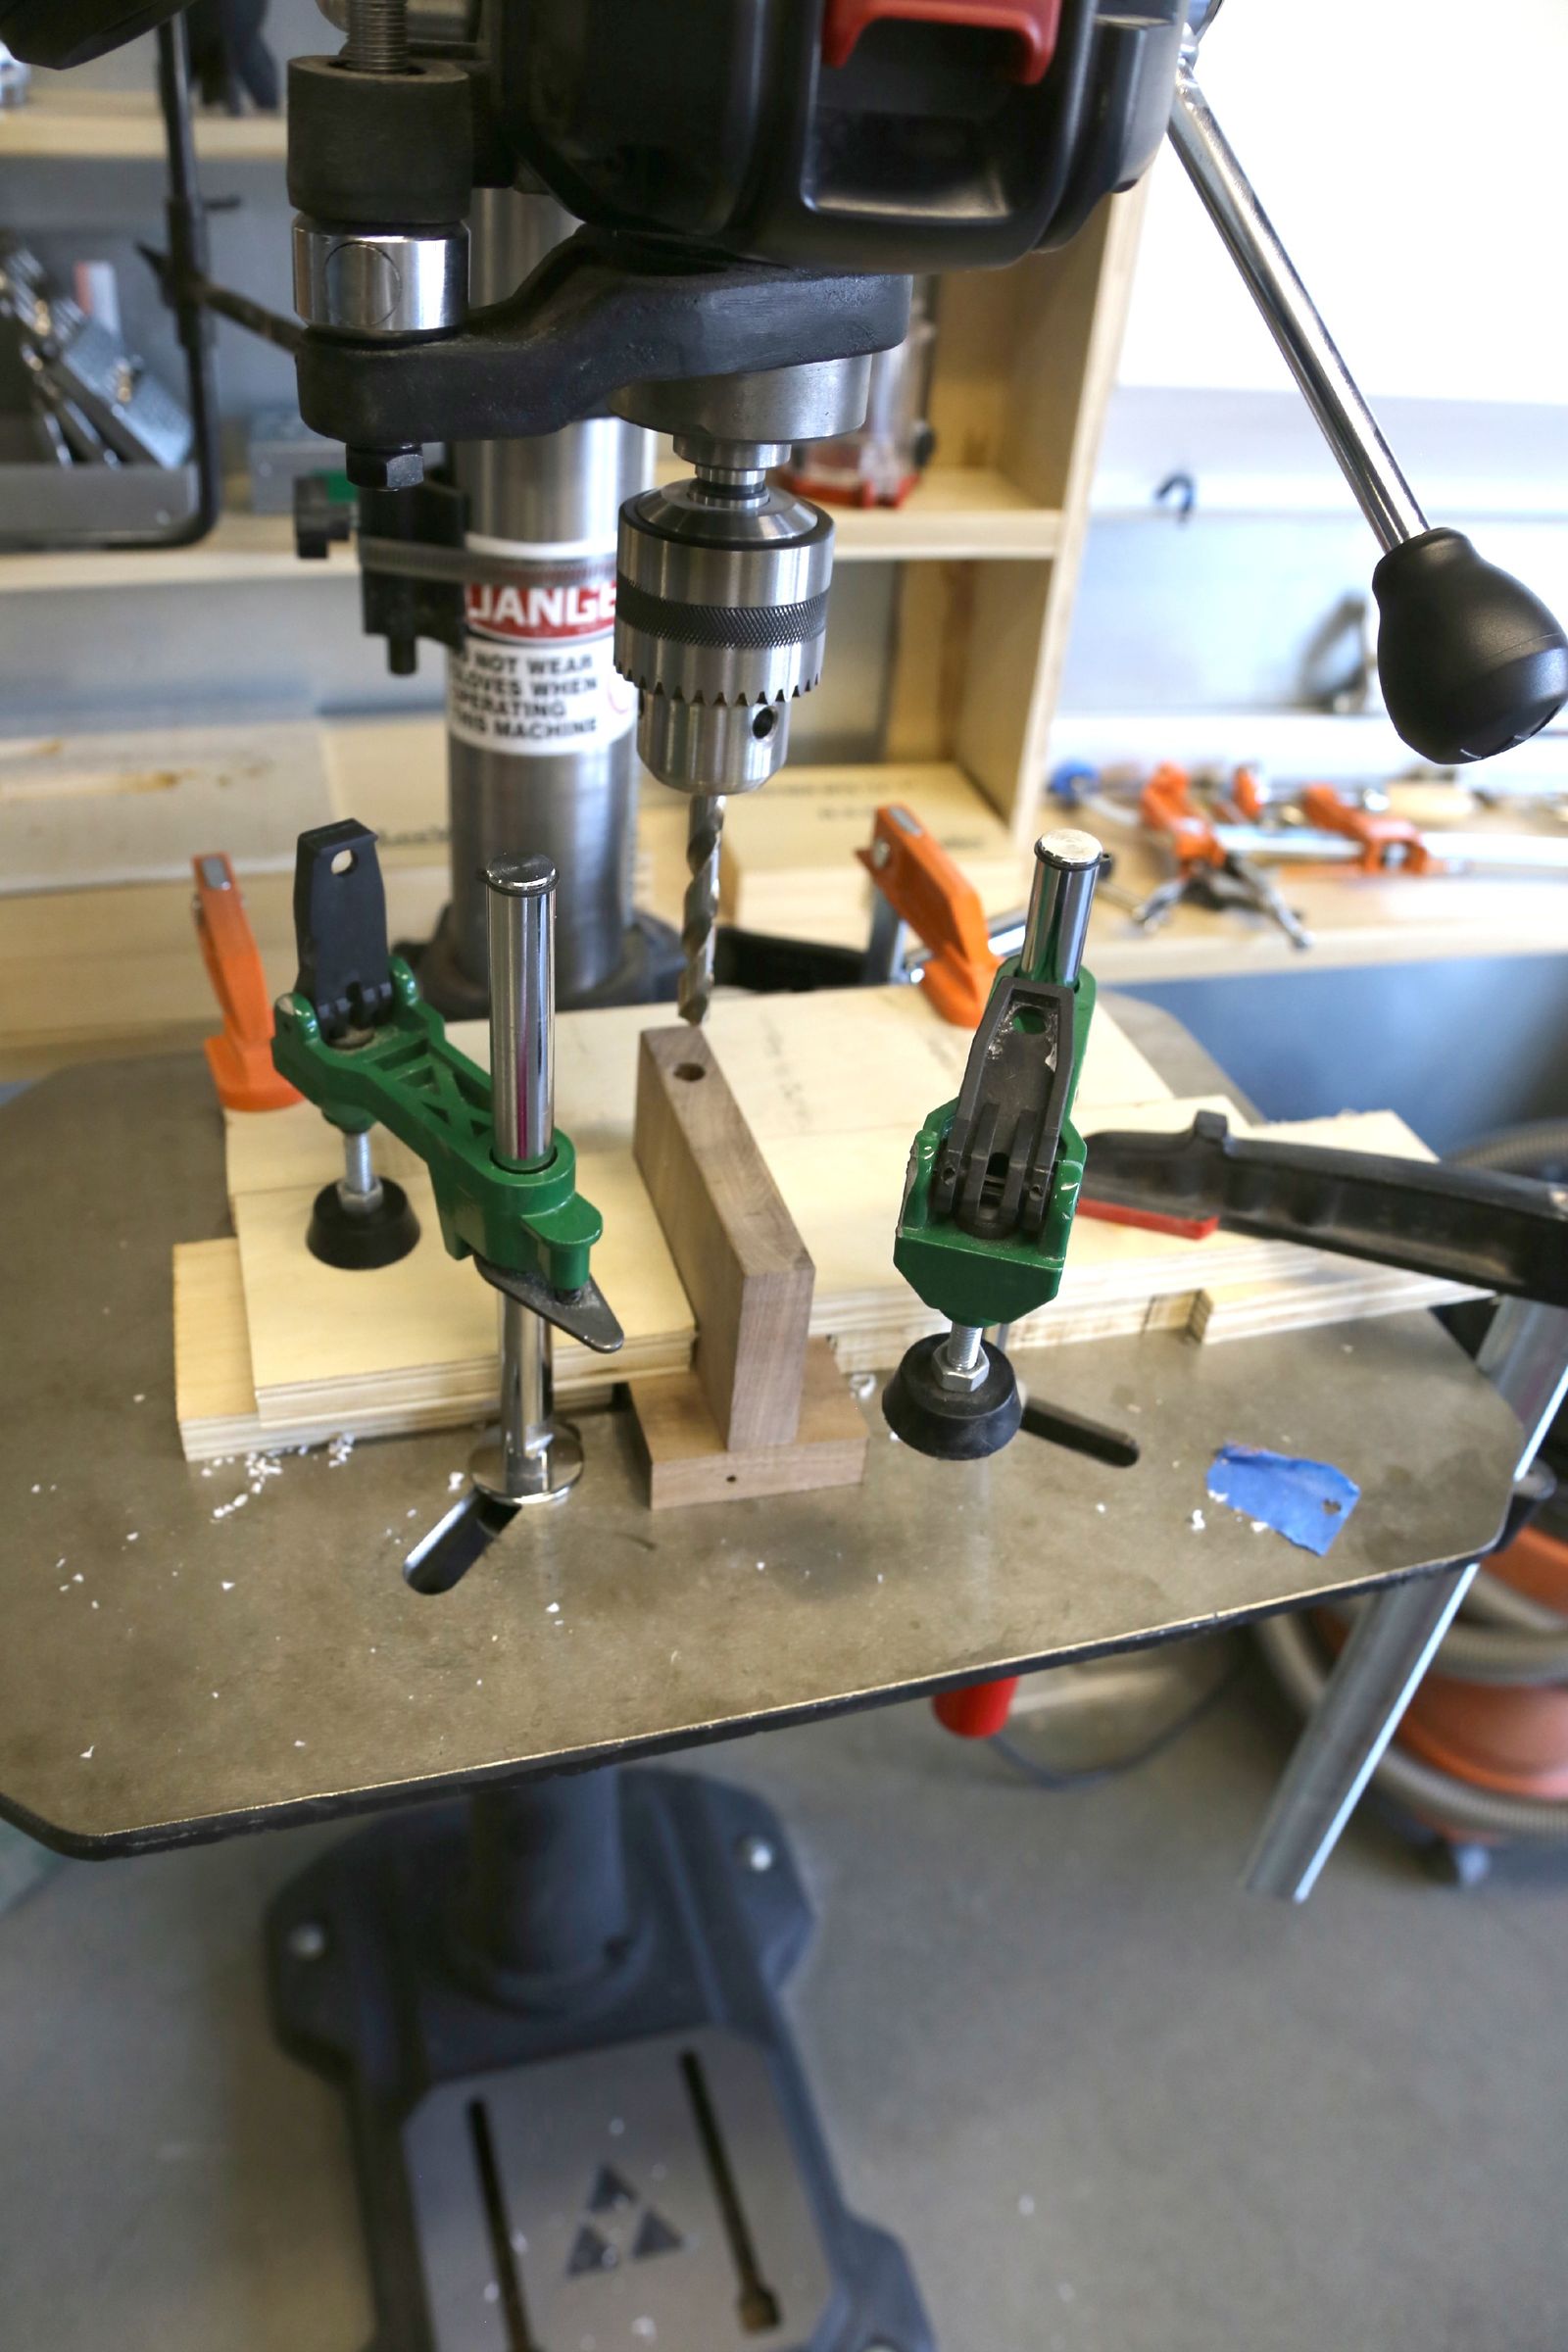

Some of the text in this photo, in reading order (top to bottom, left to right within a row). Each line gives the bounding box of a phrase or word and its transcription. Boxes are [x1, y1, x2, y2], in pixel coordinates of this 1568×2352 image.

[468, 582, 617, 627] DANGE
[475, 653, 517, 673] NOT
[527, 654, 593, 674] WEAR
[454, 668, 598, 697] LOVES WHEN
[456, 688, 565, 716] PERATING
[457, 710, 597, 738] HIS MACHINE
